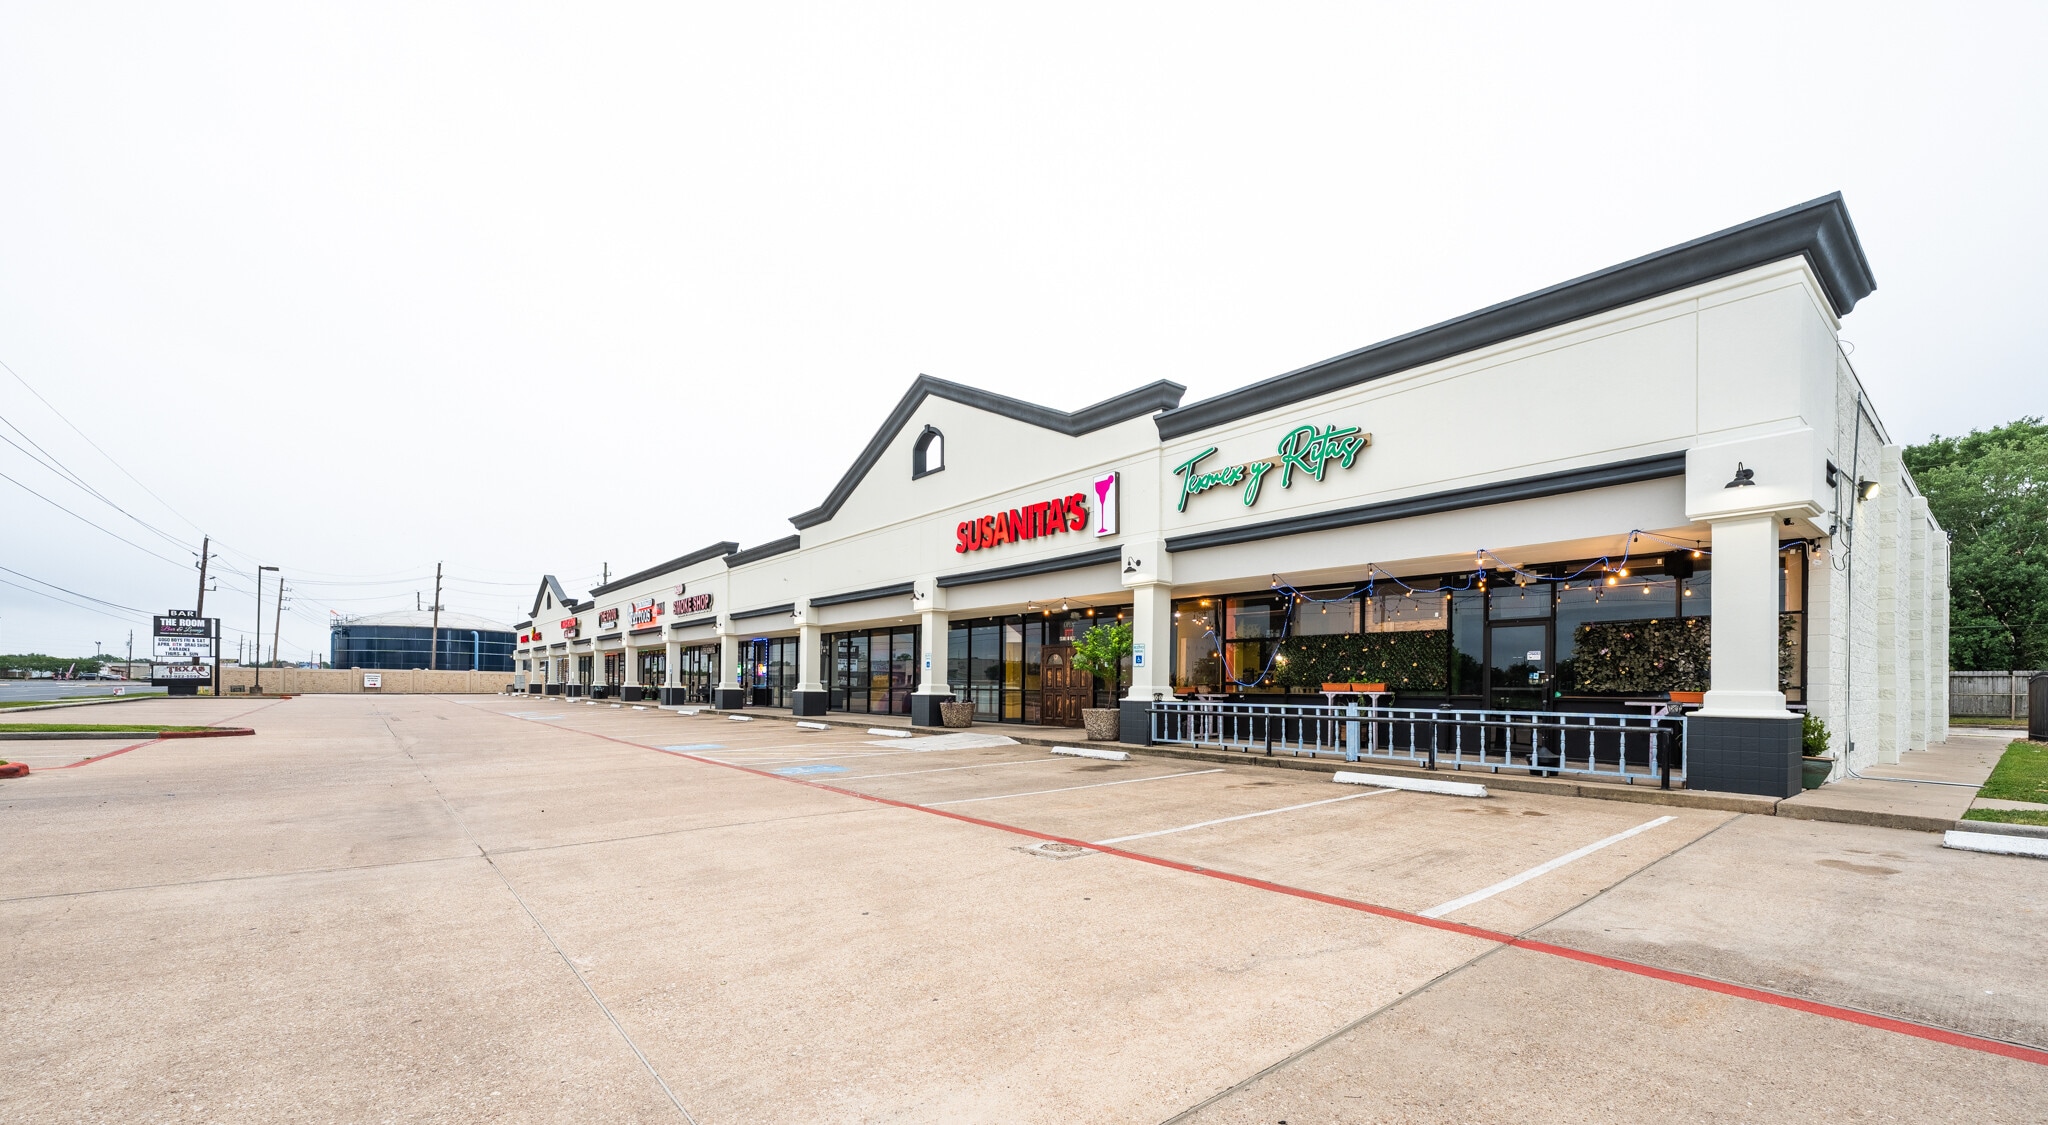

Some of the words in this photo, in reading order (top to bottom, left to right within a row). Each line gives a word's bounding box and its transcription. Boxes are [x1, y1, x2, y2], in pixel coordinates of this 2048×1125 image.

[1243, 461, 1273, 507] y
[1277, 424, 1367, 489] Ritas
[955, 492, 1088, 554] SUSANITA'S
[673, 599, 692, 615] SMOKE
[692, 594, 710, 612] SHOP
[160, 618, 176, 626] THE
[179, 619, 205, 627] ROOM
[166, 666, 206, 675] TEXAS
